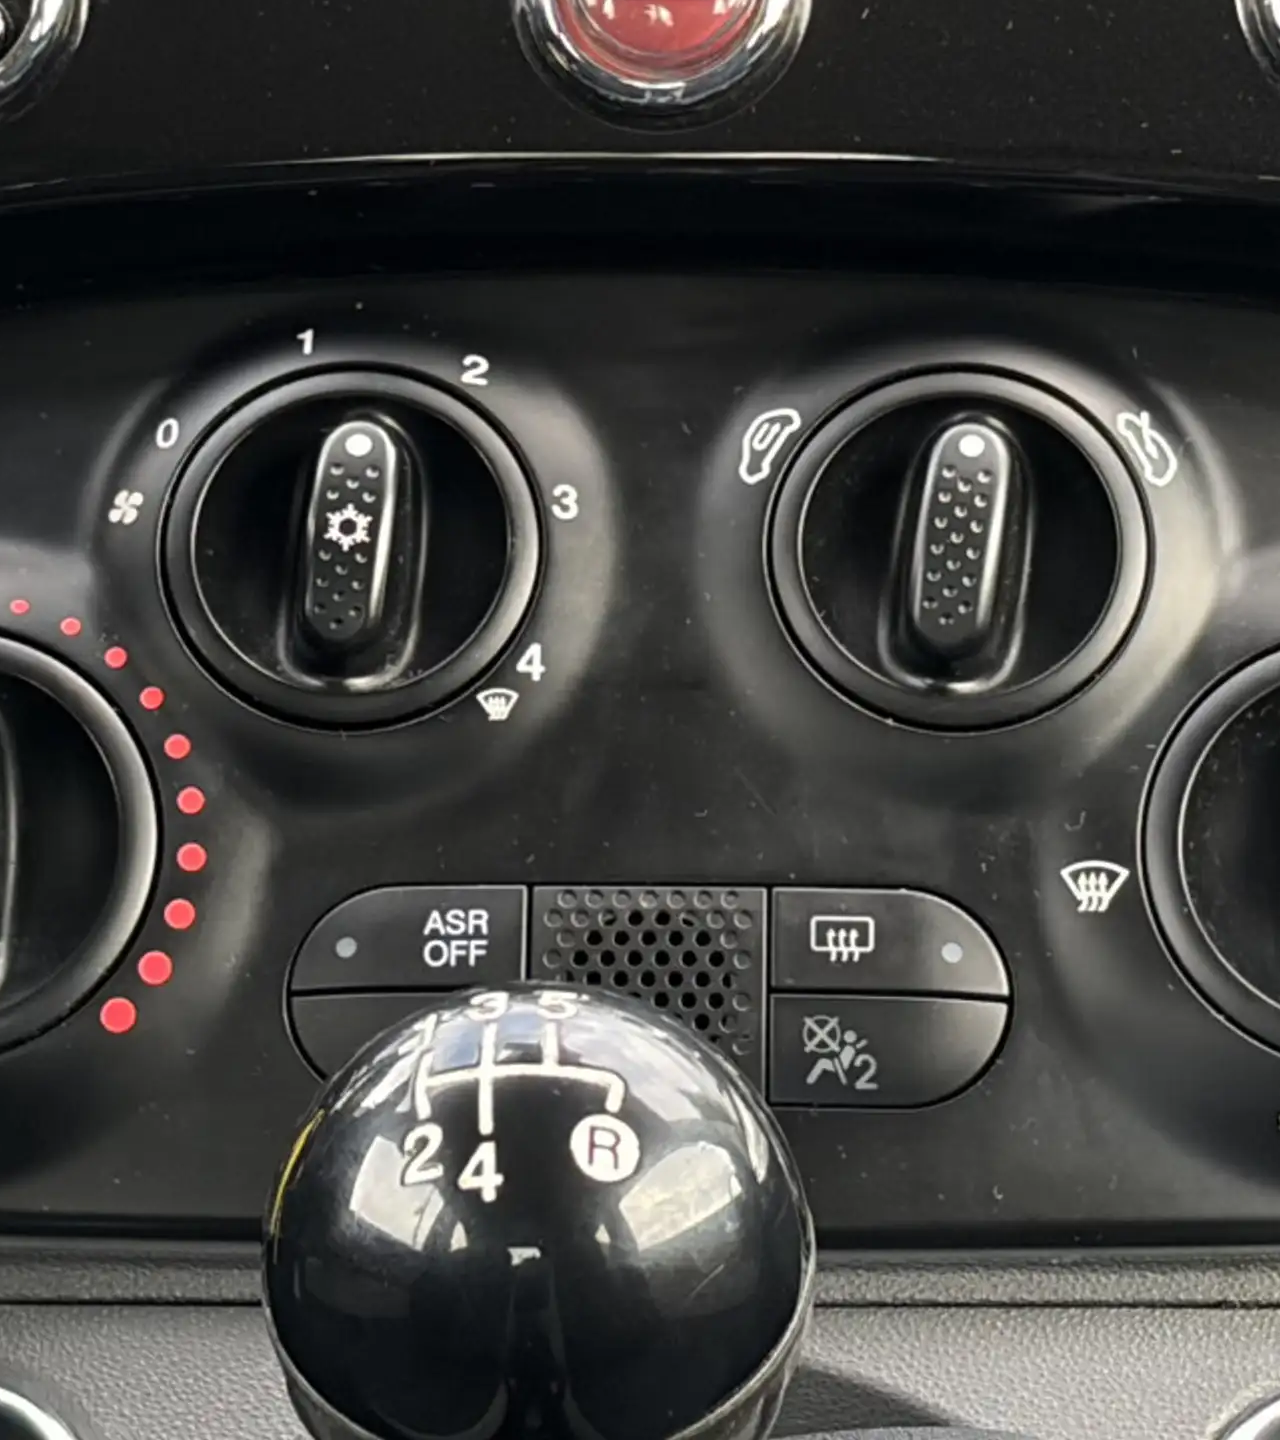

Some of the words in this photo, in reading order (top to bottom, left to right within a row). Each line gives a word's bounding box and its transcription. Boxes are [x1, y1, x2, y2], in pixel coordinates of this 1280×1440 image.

[296, 328, 316, 356] 1
[460, 354, 490, 387] 2
[550, 483, 580, 521] 3
[516, 642, 546, 682] 4
[423, 910, 490, 937] ASR
[422, 939, 489, 967] OFF
[468, 991, 510, 1021] 3
[401, 1123, 444, 1186] 2
[457, 1139, 505, 1203] 4
[587, 1124, 623, 1171] R
